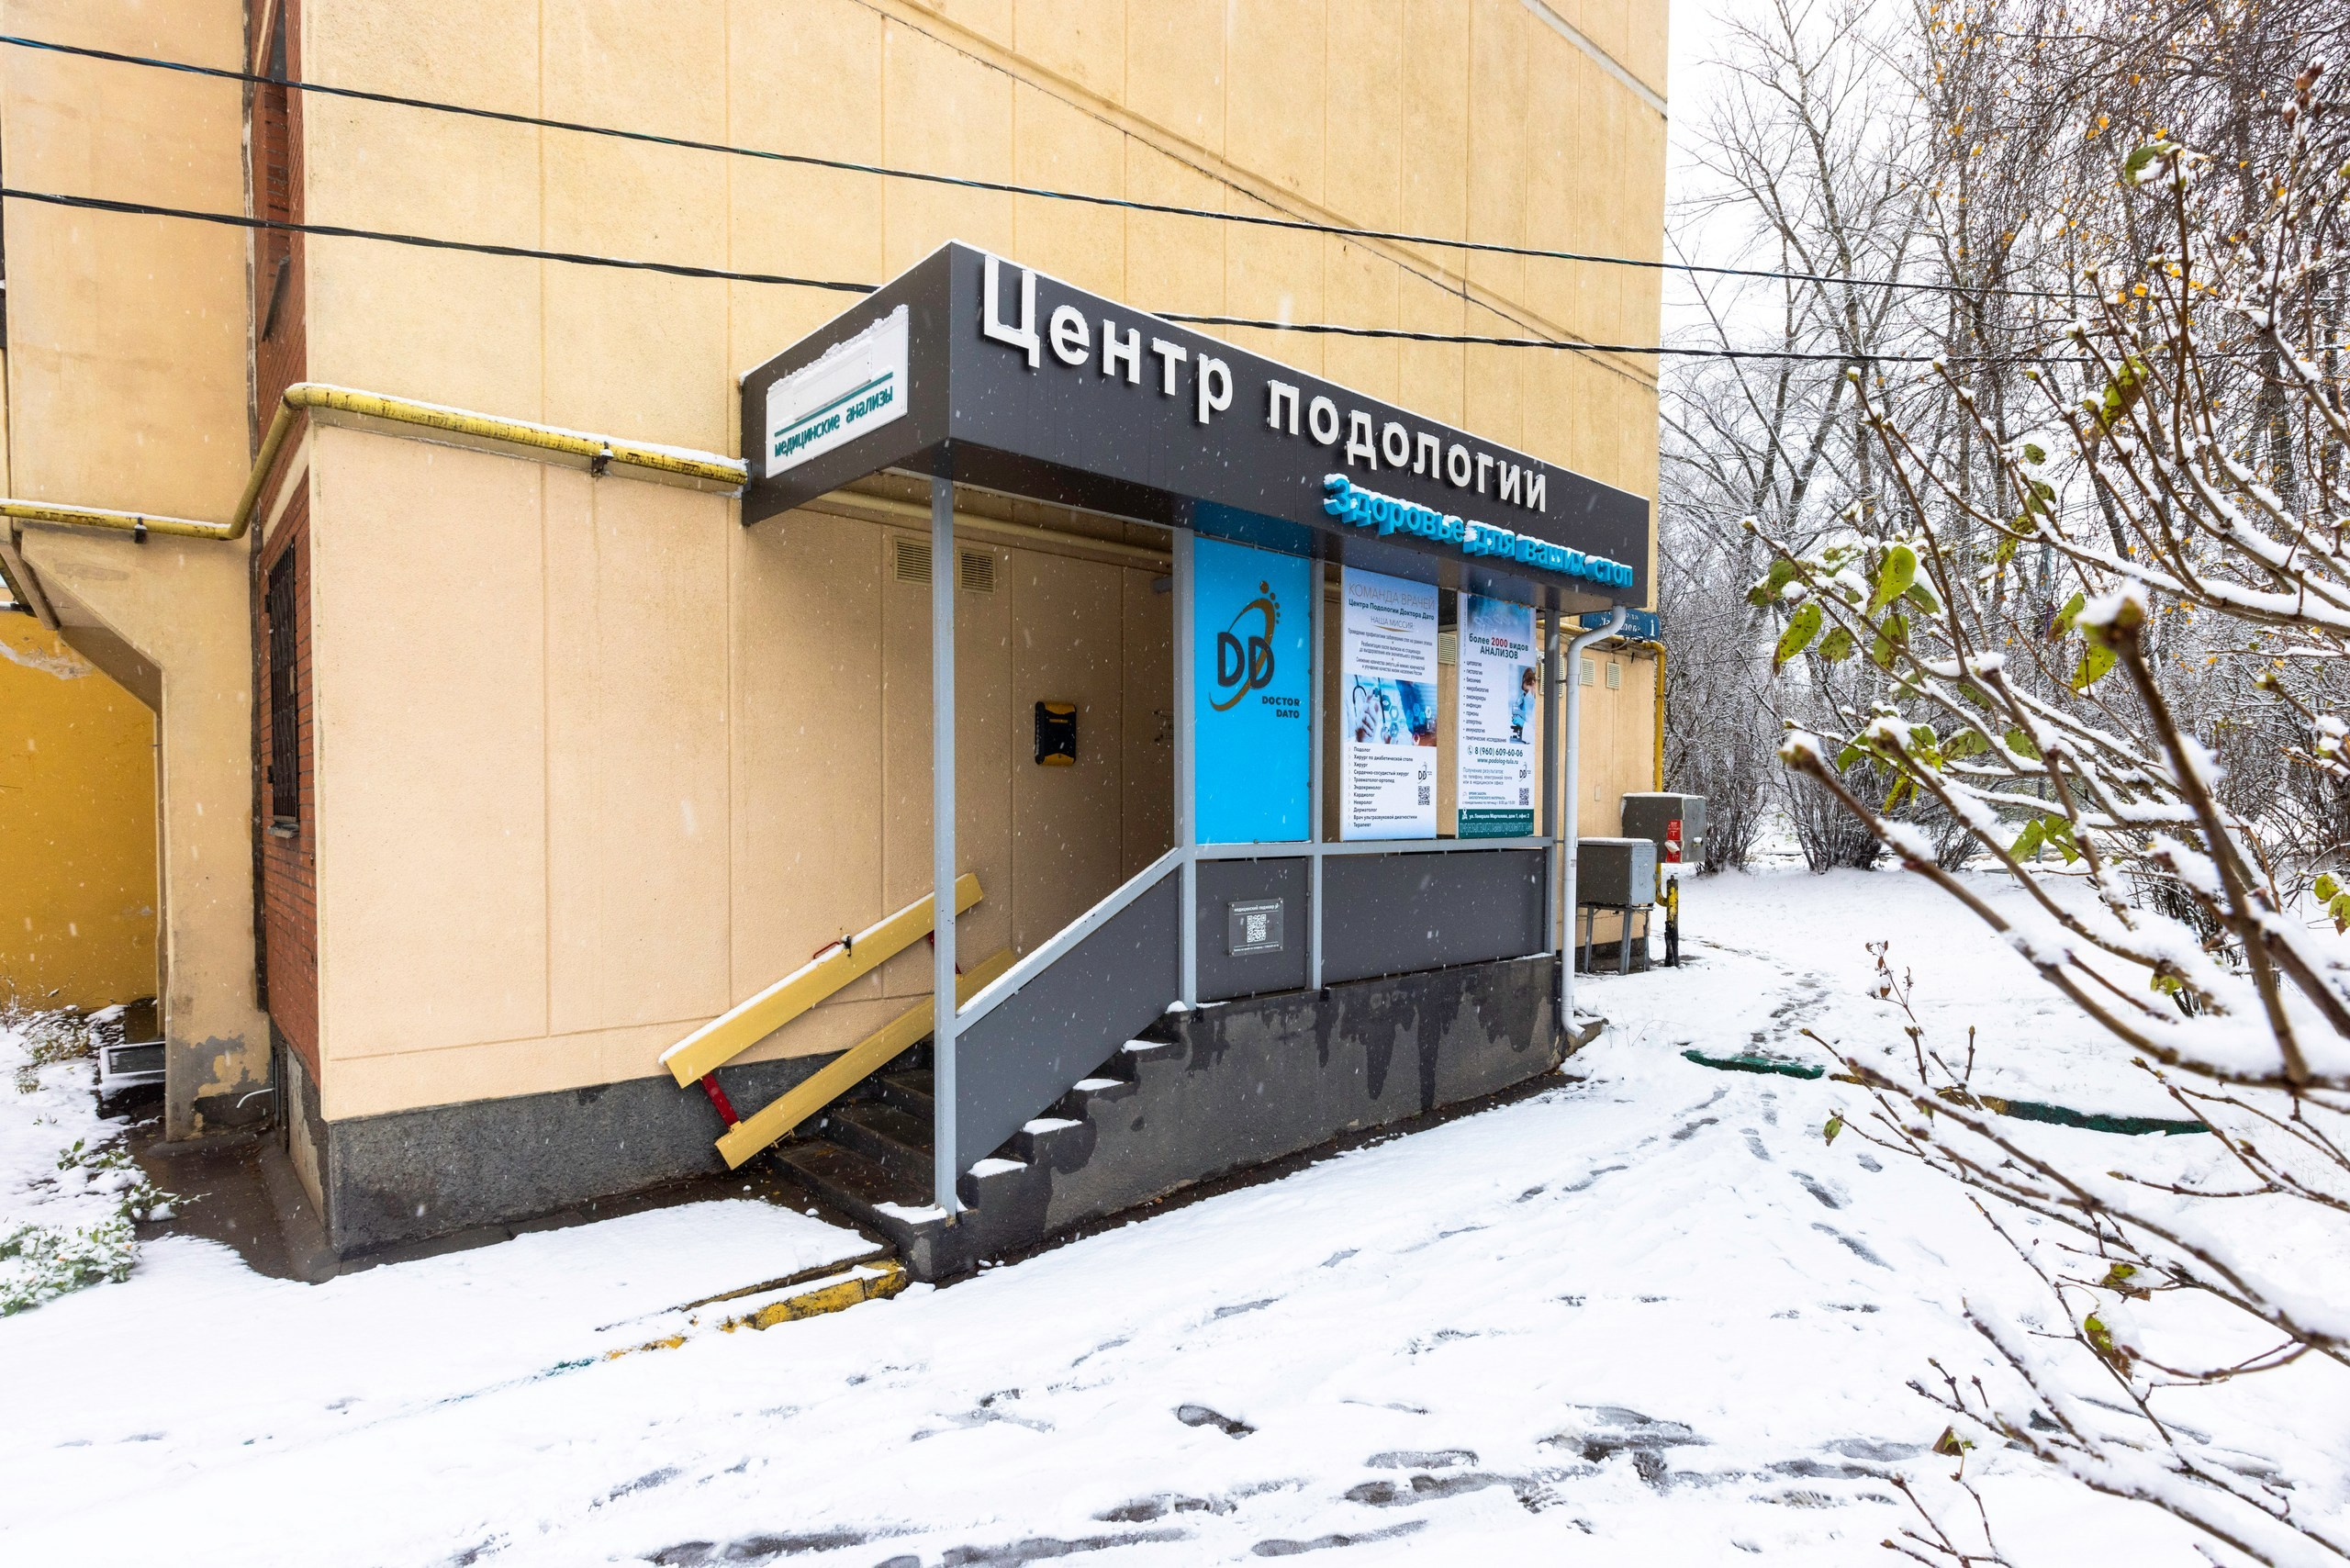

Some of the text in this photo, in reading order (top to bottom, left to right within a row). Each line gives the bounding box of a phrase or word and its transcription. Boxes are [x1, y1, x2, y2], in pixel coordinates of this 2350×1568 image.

[984, 254, 1546, 512] Центр подологии
[775, 386, 893, 457] медицинские анализы
[1324, 475, 1633, 588] Здоровье для ваших стоп
[1348, 583, 1435, 610] КОМАНДА ВРАЧЕЙ
[1348, 599, 1435, 621] Центра Подологии Доктора Дато
[1371, 616, 1414, 630] НАША МИССИЯ
[1650, 618, 1656, 637] 1
[1469, 633, 1529, 652] более 2000 видов
[1480, 645, 1518, 659] АНАЛИЗОВ
[1217, 631, 1275, 690] DD
[1262, 695, 1300, 707] DOCTOR
[1276, 709, 1300, 719] DATO
[1474, 746, 1523, 757] 8 (960) 609-60-06
